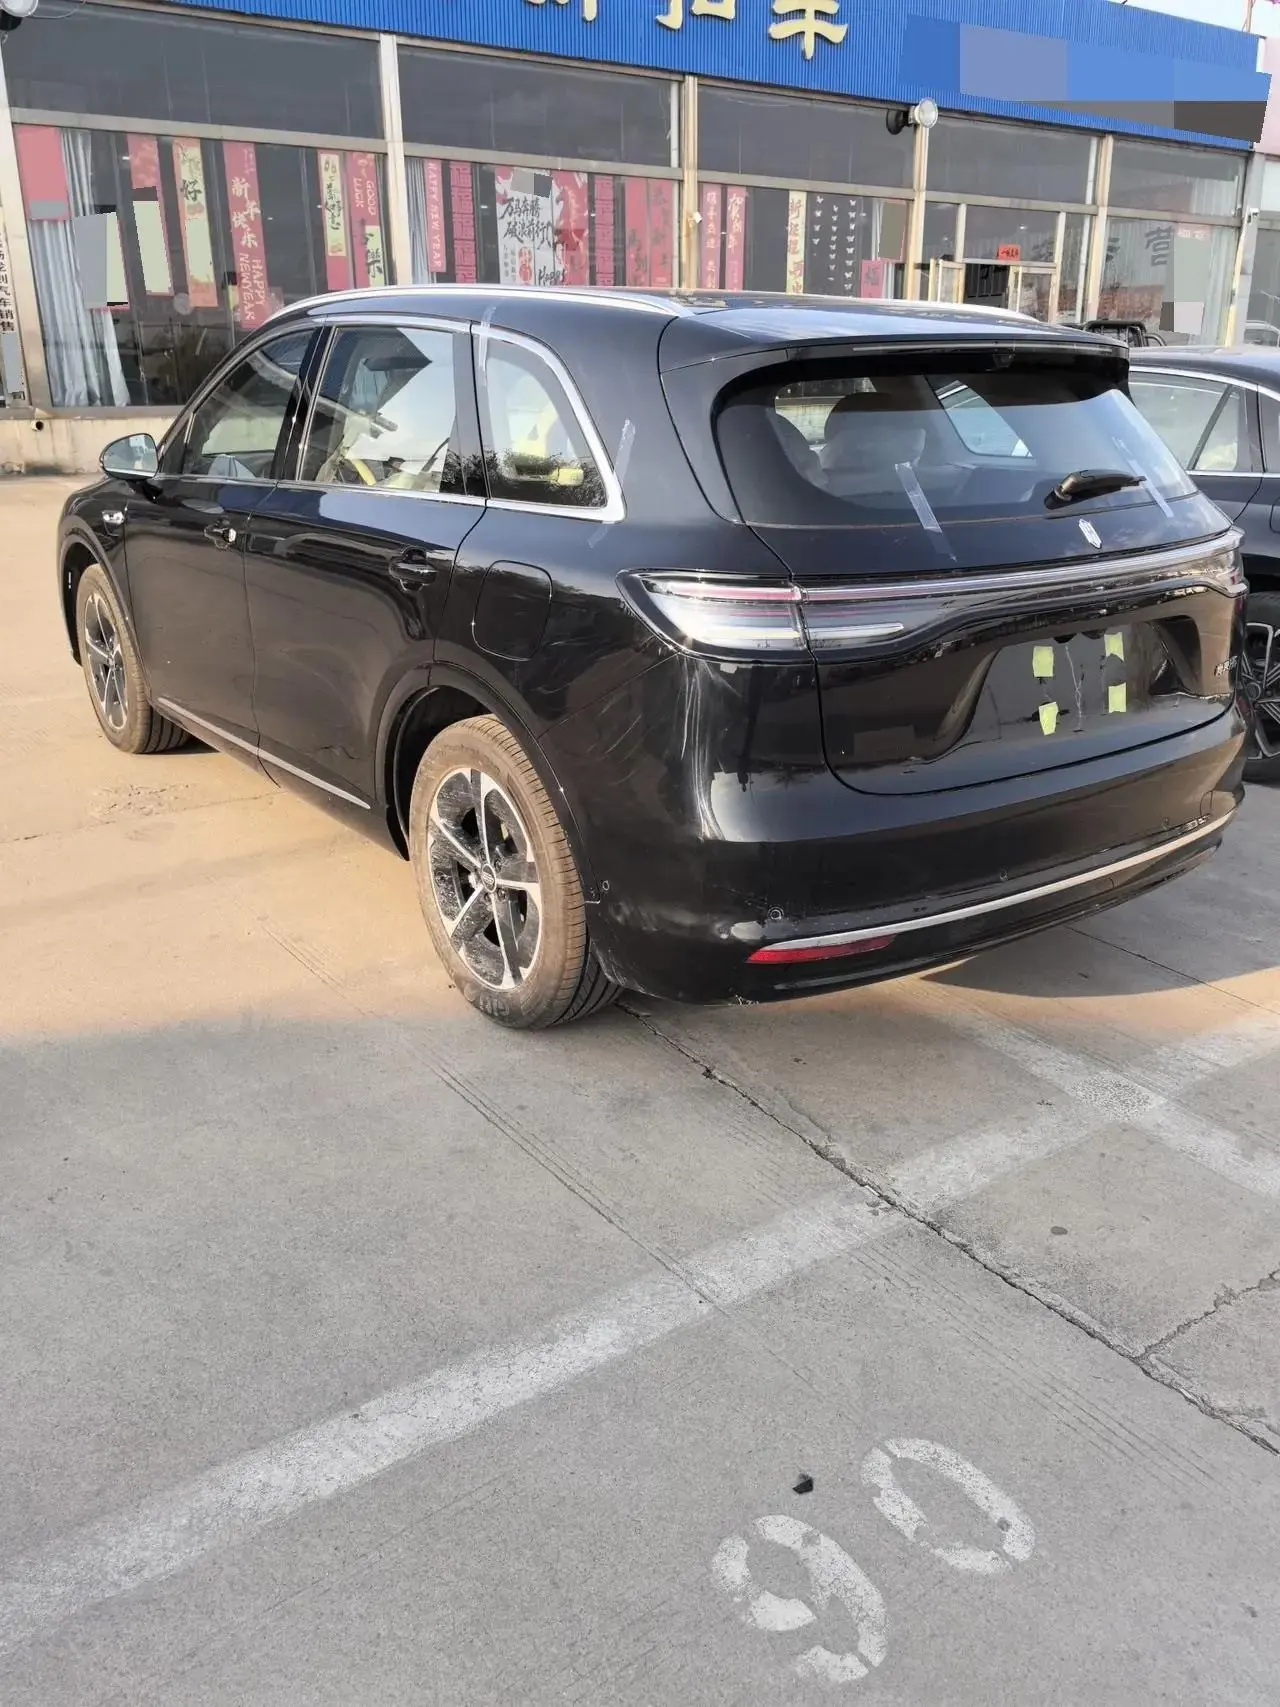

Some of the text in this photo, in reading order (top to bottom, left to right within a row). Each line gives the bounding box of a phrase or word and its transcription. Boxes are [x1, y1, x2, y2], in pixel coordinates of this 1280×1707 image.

[231, 176, 262, 249] 新年快乐
[365, 180, 377, 216] GOOD
[430, 204, 440, 231] NEW
[432, 235, 441, 267] YEAR
[251, 258, 267, 306] HAPPY
